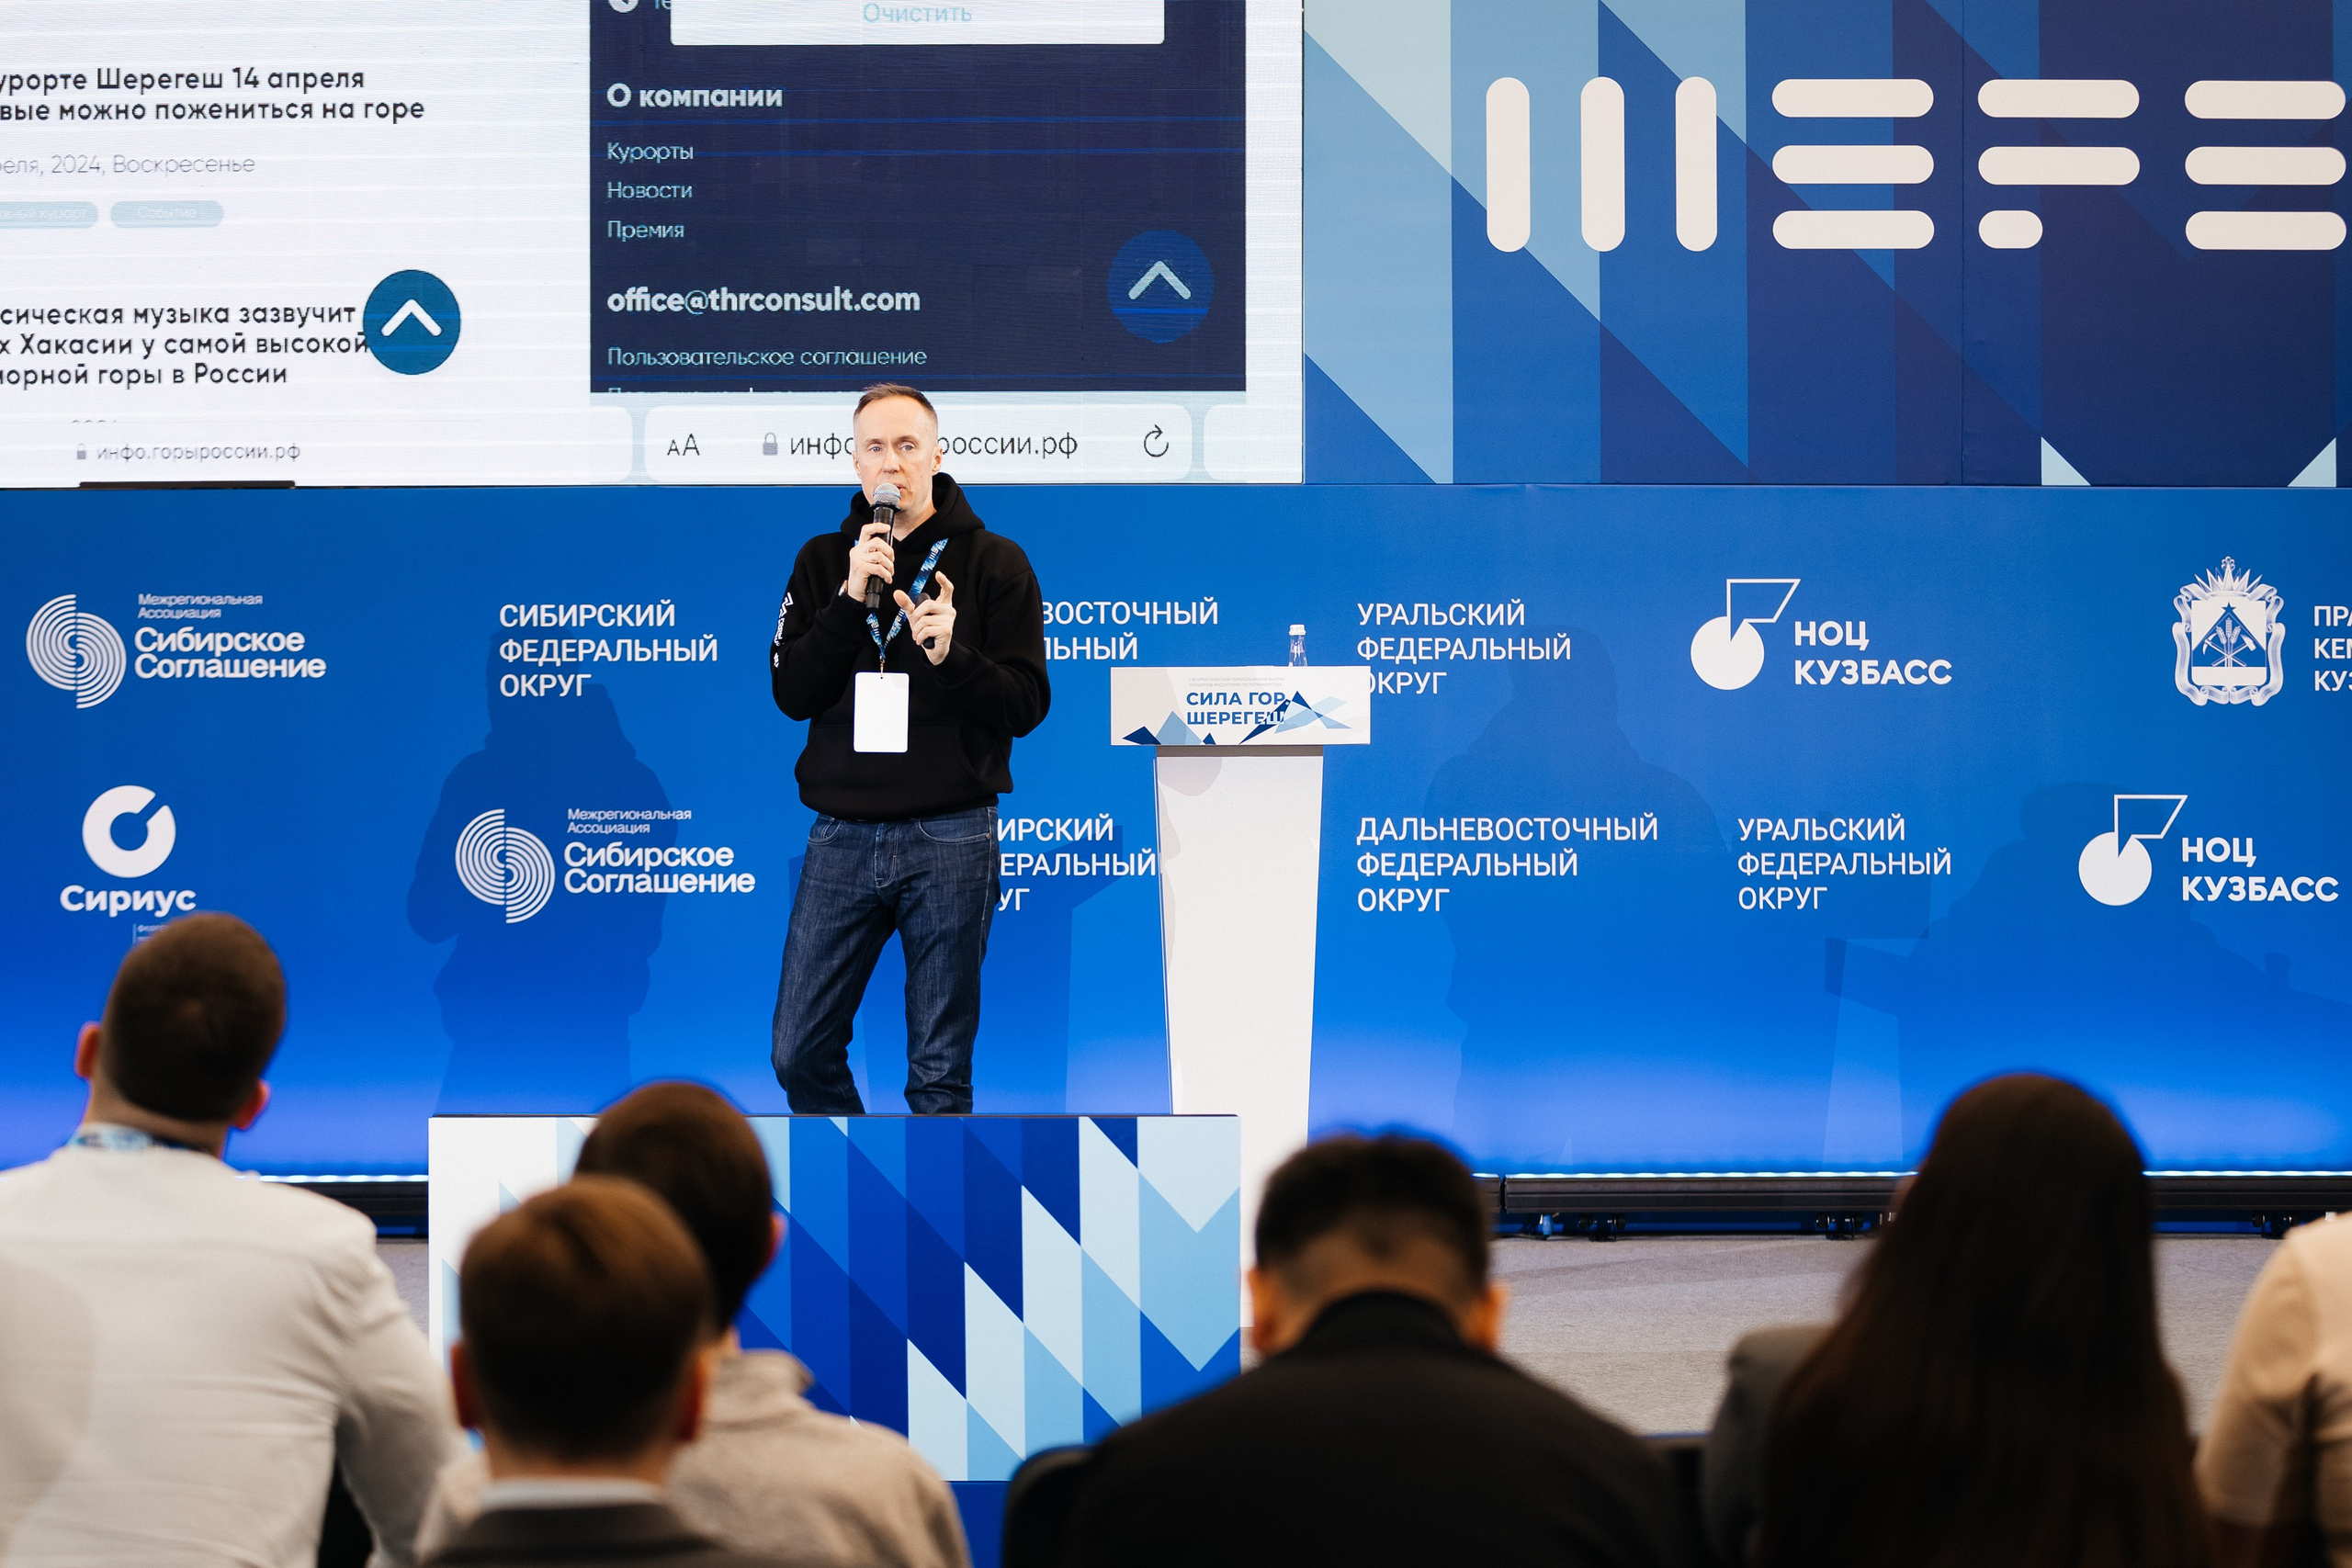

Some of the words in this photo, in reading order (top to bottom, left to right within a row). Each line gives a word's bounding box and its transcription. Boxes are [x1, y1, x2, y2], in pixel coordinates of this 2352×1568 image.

[863, 4, 972, 23] Очистить
[97, 68, 222, 95] Шерегеш
[232, 67, 259, 88] 14
[268, 73, 363, 94] апреля
[607, 84, 631, 107] О
[639, 89, 782, 107] компании
[60, 104, 145, 119] можно
[156, 103, 312, 119] пожениться
[323, 103, 354, 118] на
[365, 102, 424, 124] горе
[52, 154, 105, 175] 2024,
[114, 154, 254, 173] Воскресенье
[608, 142, 693, 164] Курорты
[608, 182, 692, 197] Новости
[608, 220, 684, 242] Премия
[607, 286, 920, 314] office@thrconsult.com
[0, 309, 122, 324] сическая
[134, 308, 229, 329] музыка
[240, 307, 356, 328] зазвучит
[21, 333, 131, 354] Хакасии
[142, 339, 154, 359] у
[164, 333, 245, 354] самой
[256, 333, 368, 354] высокой
[609, 347, 794, 366] Пользовательское
[800, 352, 927, 365] соглашение
[0, 364, 87, 390] орной
[99, 369, 161, 389] горы
[174, 369, 185, 383] в
[196, 363, 286, 383] России
[98, 446, 300, 461] инфо.горыроссии.рф
[139, 593, 263, 606] Межрегиональная
[138, 607, 221, 619] Ассоциация
[500, 599, 674, 626] СИБИРСКИЙ
[1358, 599, 1524, 626] УРАЛЬСКИЙ
[2314, 606, 2352, 626] ПР
[135, 626, 305, 659] Сибирское
[1795, 621, 1869, 650] НОЦ
[500, 634, 717, 666] ФЕДЕРАЛЬНЫЙ
[1358, 633, 1570, 664] ФЕДЕРАЛЬНЫЙ
[135, 650, 326, 678] Соглашение
[1795, 660, 1951, 684] КУЗБАСС
[501, 674, 592, 696] ОКРУГ
[1186, 692, 1242, 705] СИЛА
[1187, 712, 1283, 724] ШЕРЕГЕШ
[568, 808, 692, 821] Межрегиональная
[567, 822, 650, 834] Ассоциация
[1357, 814, 1657, 845] ДАЛЬНЕВОСТОЧНЫЙ
[1738, 814, 1905, 840] УРАЛЬСКИЙ
[564, 841, 736, 874] Сибирское
[1357, 848, 1577, 881] ФЕДЕРАЛЬНЫЙ
[1738, 848, 1951, 880] ФЕДЕРАЛЬНЫЙ
[2183, 838, 2256, 867] НОЦ
[565, 868, 755, 893] Соглашение
[2183, 876, 2338, 901] КУЗБАСС
[60, 886, 197, 918] Сириус
[1358, 888, 1450, 911] ОКРУГ
[1739, 887, 1827, 909] ОКРУГ
